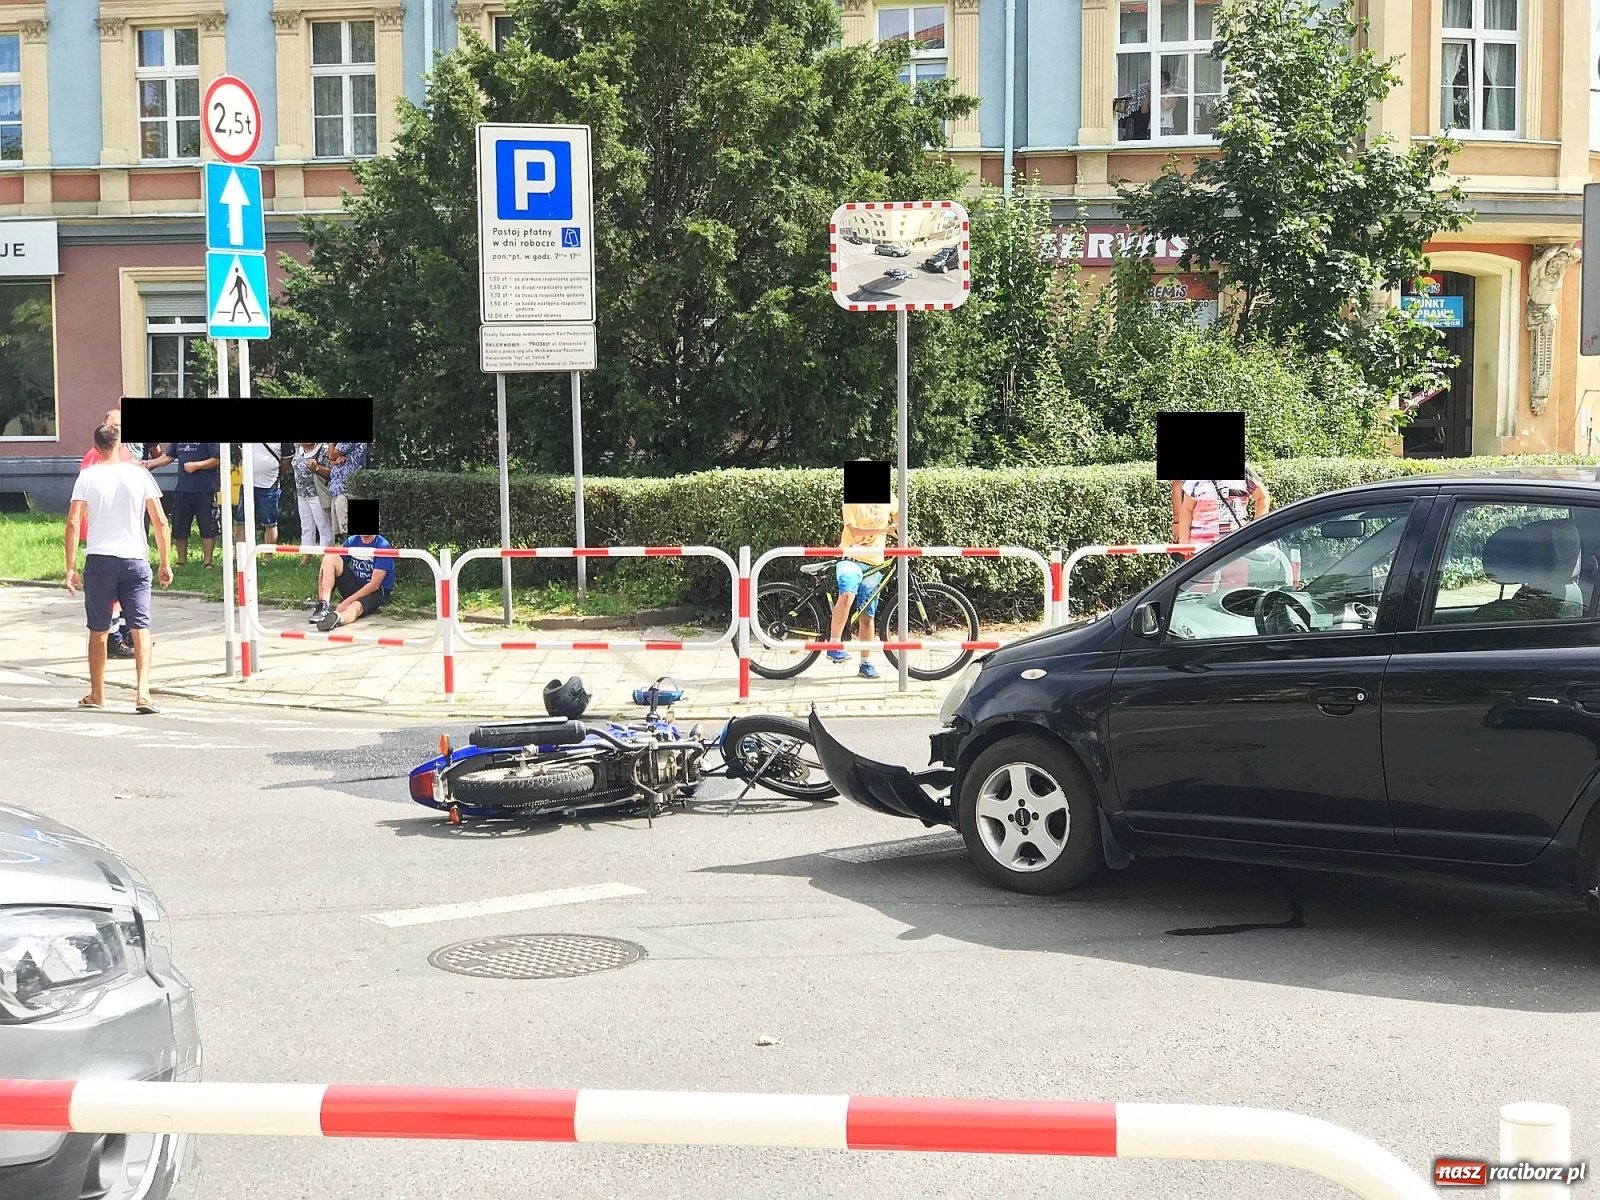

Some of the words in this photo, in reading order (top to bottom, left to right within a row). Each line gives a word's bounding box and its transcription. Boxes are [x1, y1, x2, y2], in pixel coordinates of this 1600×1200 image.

[213, 102, 252, 137] 2,5t
[513, 148, 556, 211] P
[492, 227, 520, 237] Postój
[523, 228, 552, 237] płatny
[502, 239, 517, 247] dni
[520, 239, 556, 247] robocze
